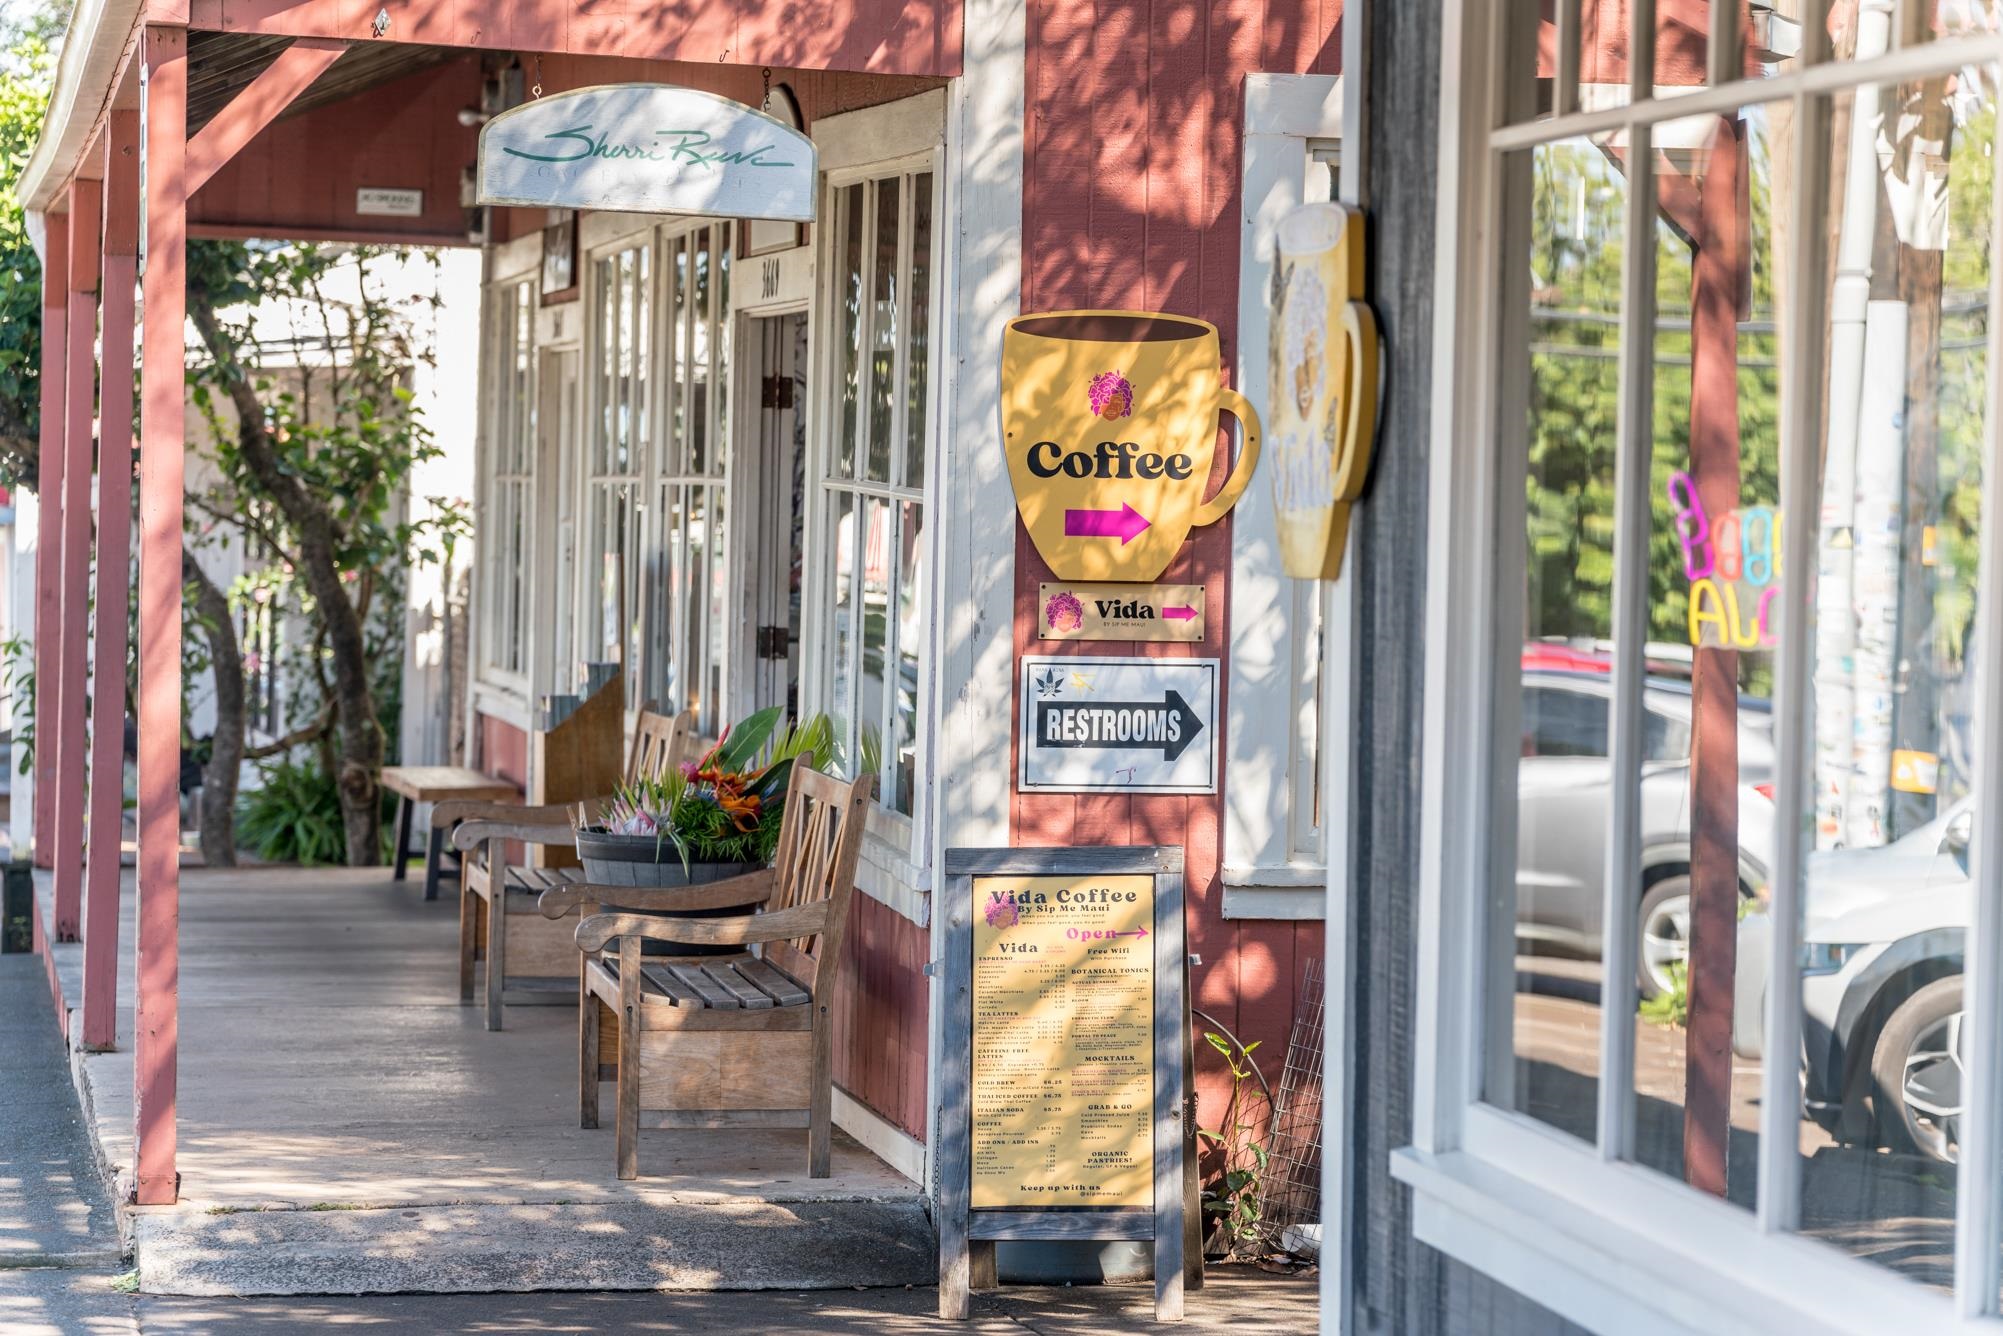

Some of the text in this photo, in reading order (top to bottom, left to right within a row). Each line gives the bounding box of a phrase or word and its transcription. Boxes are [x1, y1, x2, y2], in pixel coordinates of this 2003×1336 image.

[503, 125, 664, 162] Sherri
[1027, 441, 1193, 480] Coffee
[1095, 599, 1155, 619] Vida
[1046, 709, 1181, 743] RESTROOMS
[991, 888, 1137, 904] Vida Coffee
[1018, 905, 1033, 914] By
[1036, 904, 1056, 914] Sip
[1080, 903, 1110, 912] Maui
[1066, 928, 1117, 942] Open
[999, 943, 1038, 953] Vida
